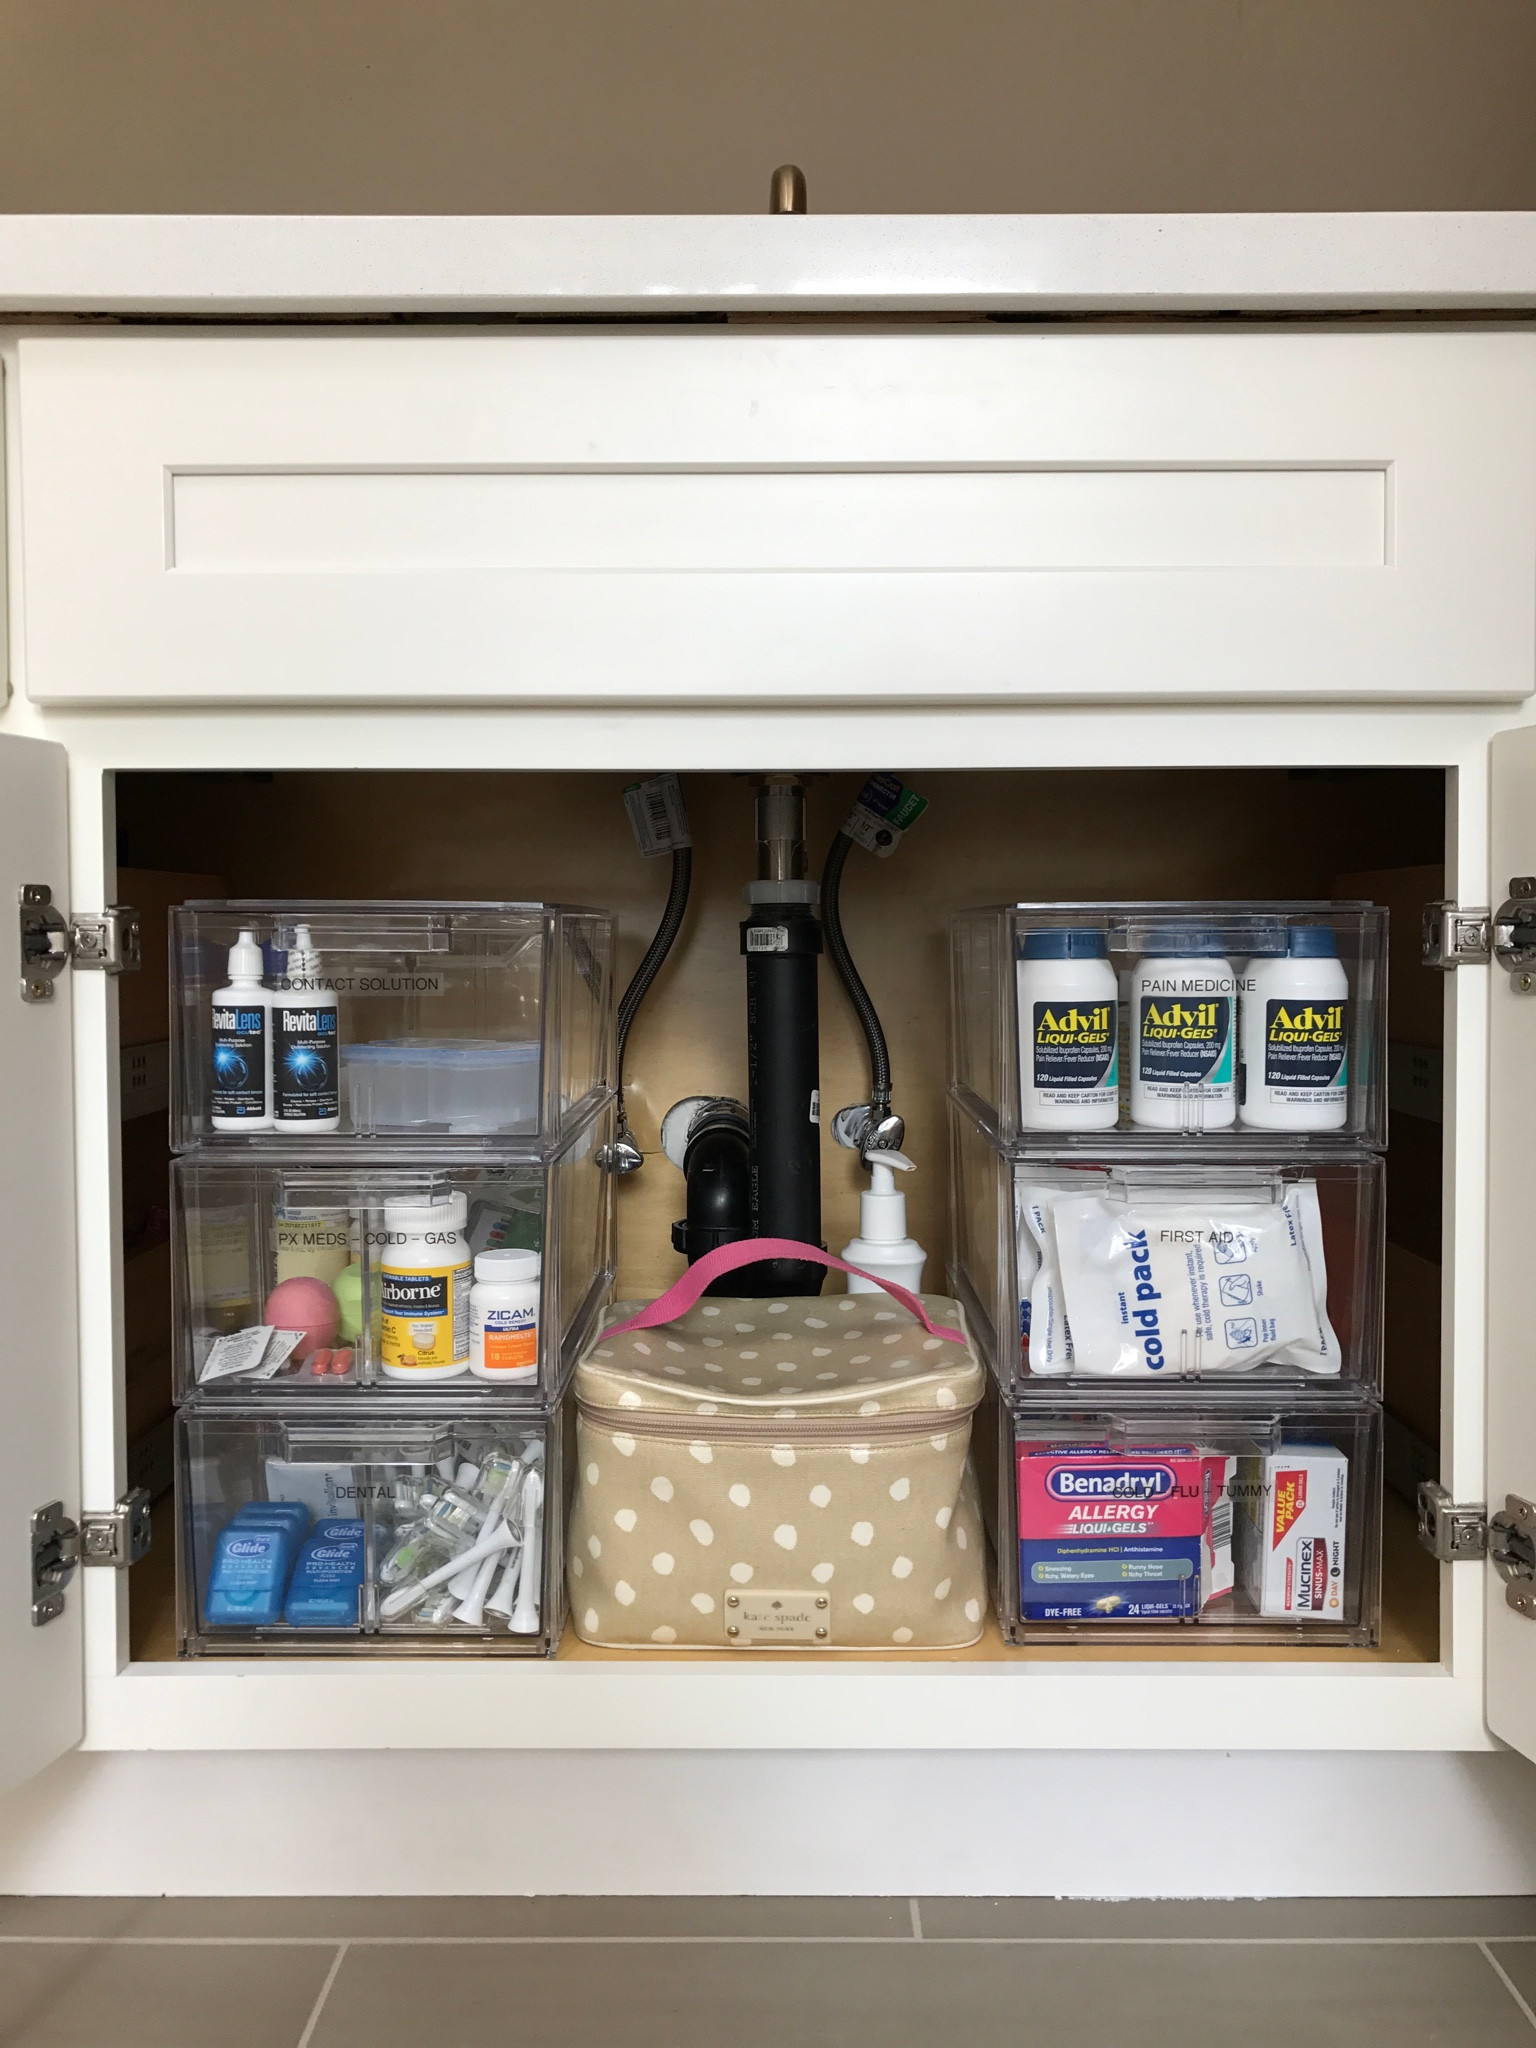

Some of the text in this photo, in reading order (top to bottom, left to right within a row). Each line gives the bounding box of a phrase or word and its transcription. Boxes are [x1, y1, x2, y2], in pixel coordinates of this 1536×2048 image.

[893, 794, 920, 825] FAUCET
[281, 977, 438, 991] CONTACT SOLUTION
[1142, 979, 1256, 992] PAIN MEDICINE
[283, 1009, 336, 1031] RevitaLens
[1037, 1007, 1108, 1031] Advil
[1143, 1003, 1218, 1026] Advil
[1269, 1006, 1343, 1030] Advil
[751, 1165, 759, 1211] EAGLE
[1034, 1211, 1046, 1234] PACK
[279, 1232, 457, 1245] PX MEDS COLD GAS
[1160, 1231, 1234, 1244] FIRST AID
[1286, 1220, 1297, 1246] Latex
[1194, 1244, 1204, 1272] required
[1122, 1229, 1165, 1371] cold pack
[1190, 1278, 1200, 1311] whenever
[1200, 1282, 1210, 1309] therapy
[487, 1307, 534, 1320] ZICAM
[1117, 1291, 1129, 1325] instant
[1202, 1309, 1211, 1323] cold
[489, 1332, 531, 1340] RAPIDMELTS
[336, 1487, 396, 1499] DENTAL
[1060, 1472, 1161, 1499] Benadryl
[1113, 1485, 1272, 1498] COLD FLU TUMMY
[1285, 1482, 1295, 1520] PACK
[1068, 1505, 1159, 1521] ALLERGY
[1276, 1489, 1287, 1533] VALUE
[330, 1528, 362, 1537] Glide
[231, 1542, 266, 1553] Glide
[317, 1549, 350, 1558] Glide
[1057, 1547, 1107, 1555] Diphenhydramine
[1314, 1549, 1324, 1599] SINUS-MAX
[775, 1613, 811, 1624] spade
[1045, 1608, 1081, 1616] DYE-FREE
[1128, 1604, 1139, 1615] 24
